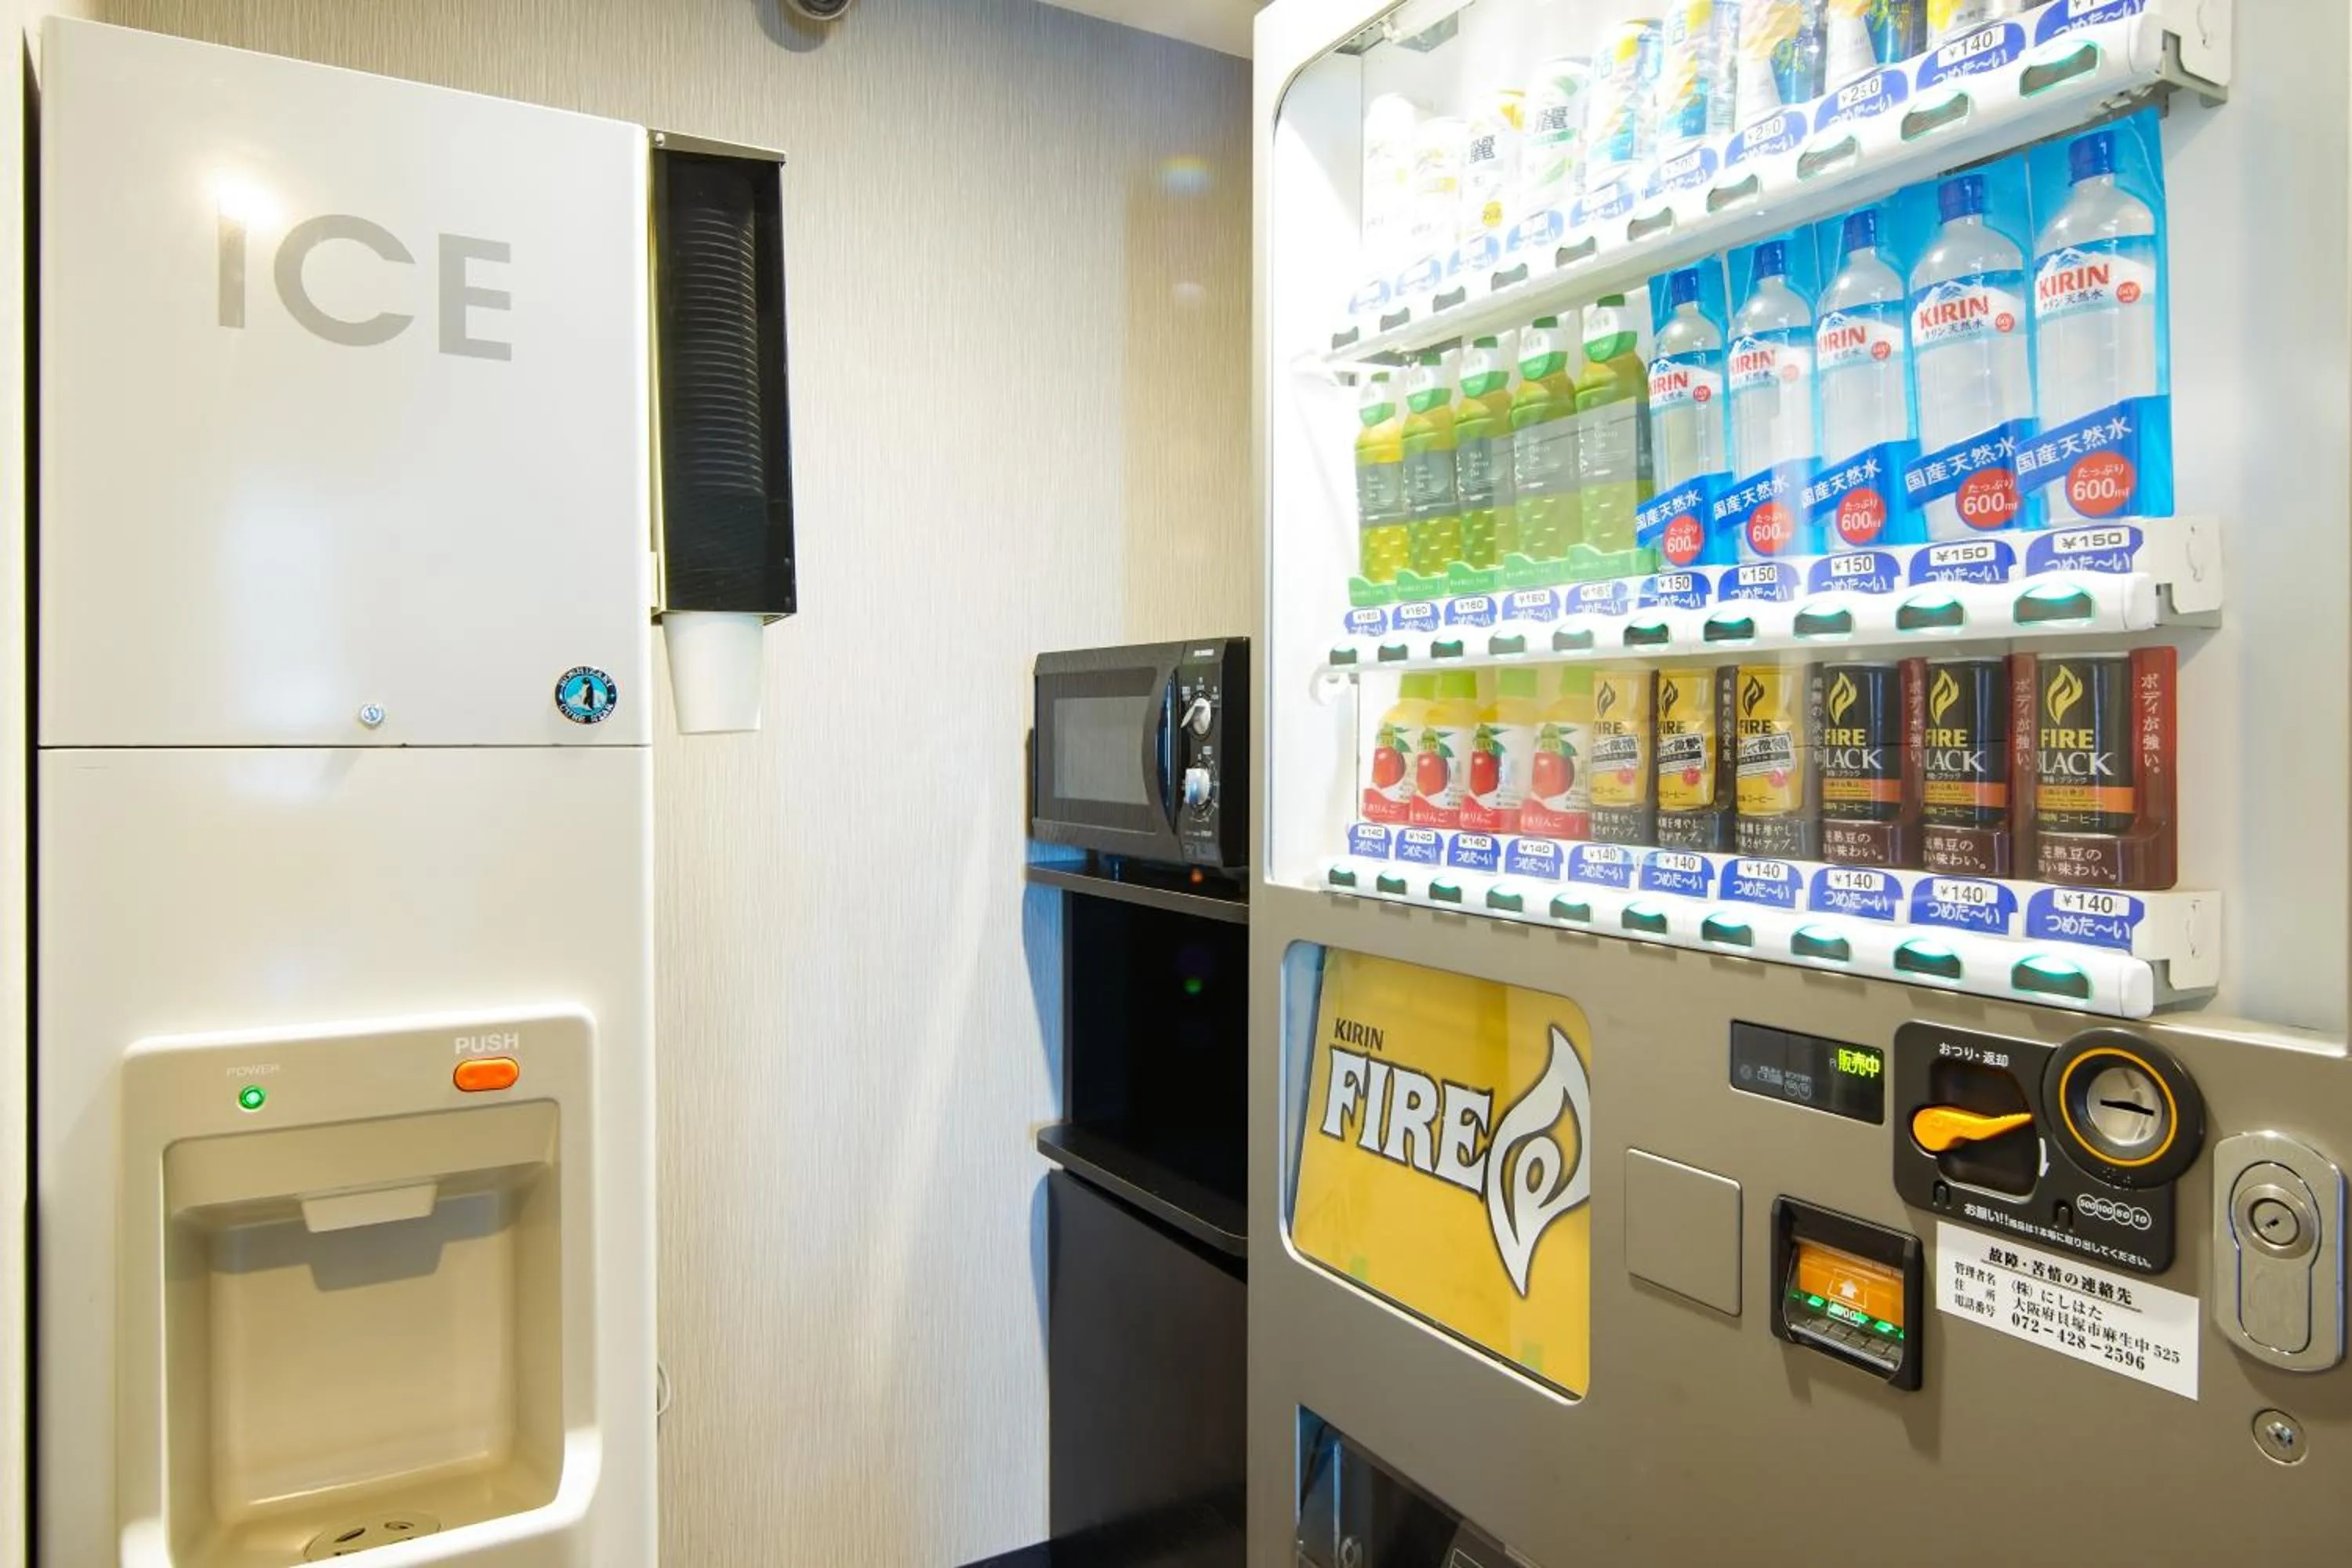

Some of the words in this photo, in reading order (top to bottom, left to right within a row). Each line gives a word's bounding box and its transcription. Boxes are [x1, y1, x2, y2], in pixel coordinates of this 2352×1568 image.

[218, 209, 512, 361] ICE
[2039, 263, 2109, 300] KIRIN
[1919, 295, 1989, 330] KIRIN
[2015, 416, 2132, 477] 国産天然水
[1905, 436, 2016, 494] 国産天然水
[1801, 458, 1882, 508] 国産天然水
[1713, 473, 1790, 521] 国産天然水
[1635, 488, 1702, 532] 国産天然水
[2061, 532, 2122, 549] ¥150
[1834, 557, 1872, 572] ¥150
[1936, 546, 1987, 561] ¥150
[1659, 577, 1690, 591] ¥150
[1742, 568, 1776, 583] ¥150
[1589, 848, 1617, 861] ¥140
[1664, 852, 1697, 869] ¥140
[1746, 863, 1780, 879] ¥140
[1834, 873, 1873, 889] ¥140
[1940, 884, 1984, 903] ¥140
[2061, 893, 2114, 913] ¥140
[455, 1033, 519, 1054] PUSH
[1334, 1018, 1384, 1051] KIRIN
[1838, 1047, 1879, 1078] 販売中
[1939, 1042, 2009, 1067] おつり・返却
[226, 1063, 280, 1077] POWER
[1319, 1045, 1493, 1201] FIRE
[2135, 1214, 2147, 1224] 10
[1955, 1261, 1996, 1287] 管理者名
[1988, 1246, 2133, 1305] 故障・苦情の連絡先
[1955, 1294, 1996, 1319] 電話番号
[2011, 1312, 2147, 1370] 072-428-2596
